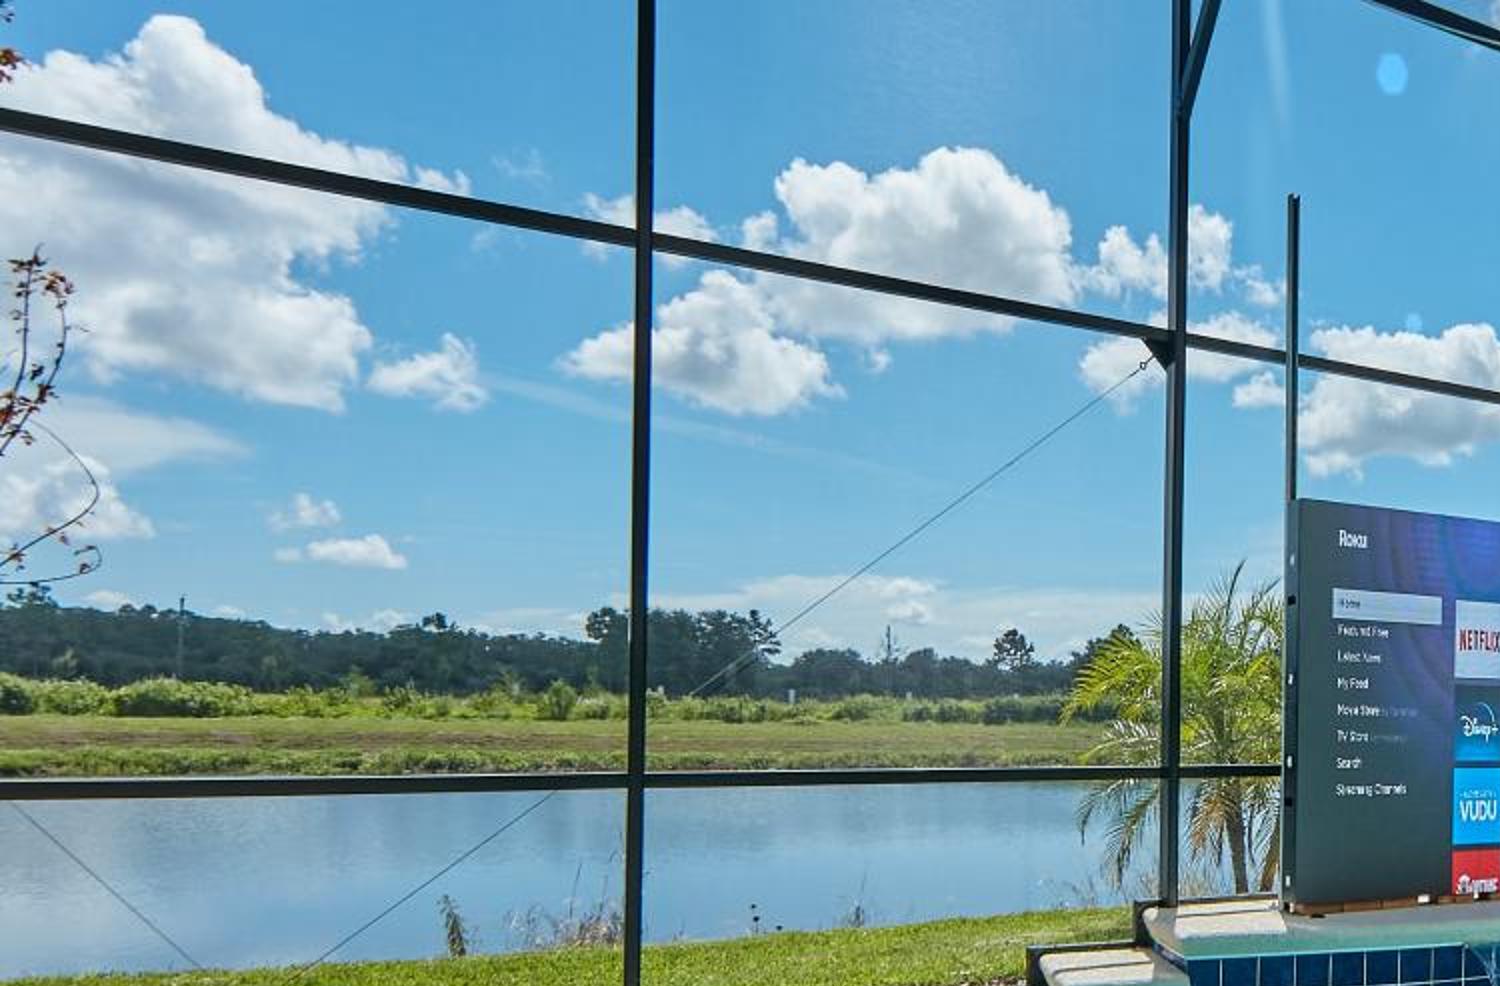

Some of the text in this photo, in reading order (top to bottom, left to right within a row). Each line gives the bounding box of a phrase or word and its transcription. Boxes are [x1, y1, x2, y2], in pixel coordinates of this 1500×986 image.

[1459, 629, 1500, 653] NETFLIX
[1337, 730, 1349, 742] TV
[1459, 799, 1497, 821] VUDU
